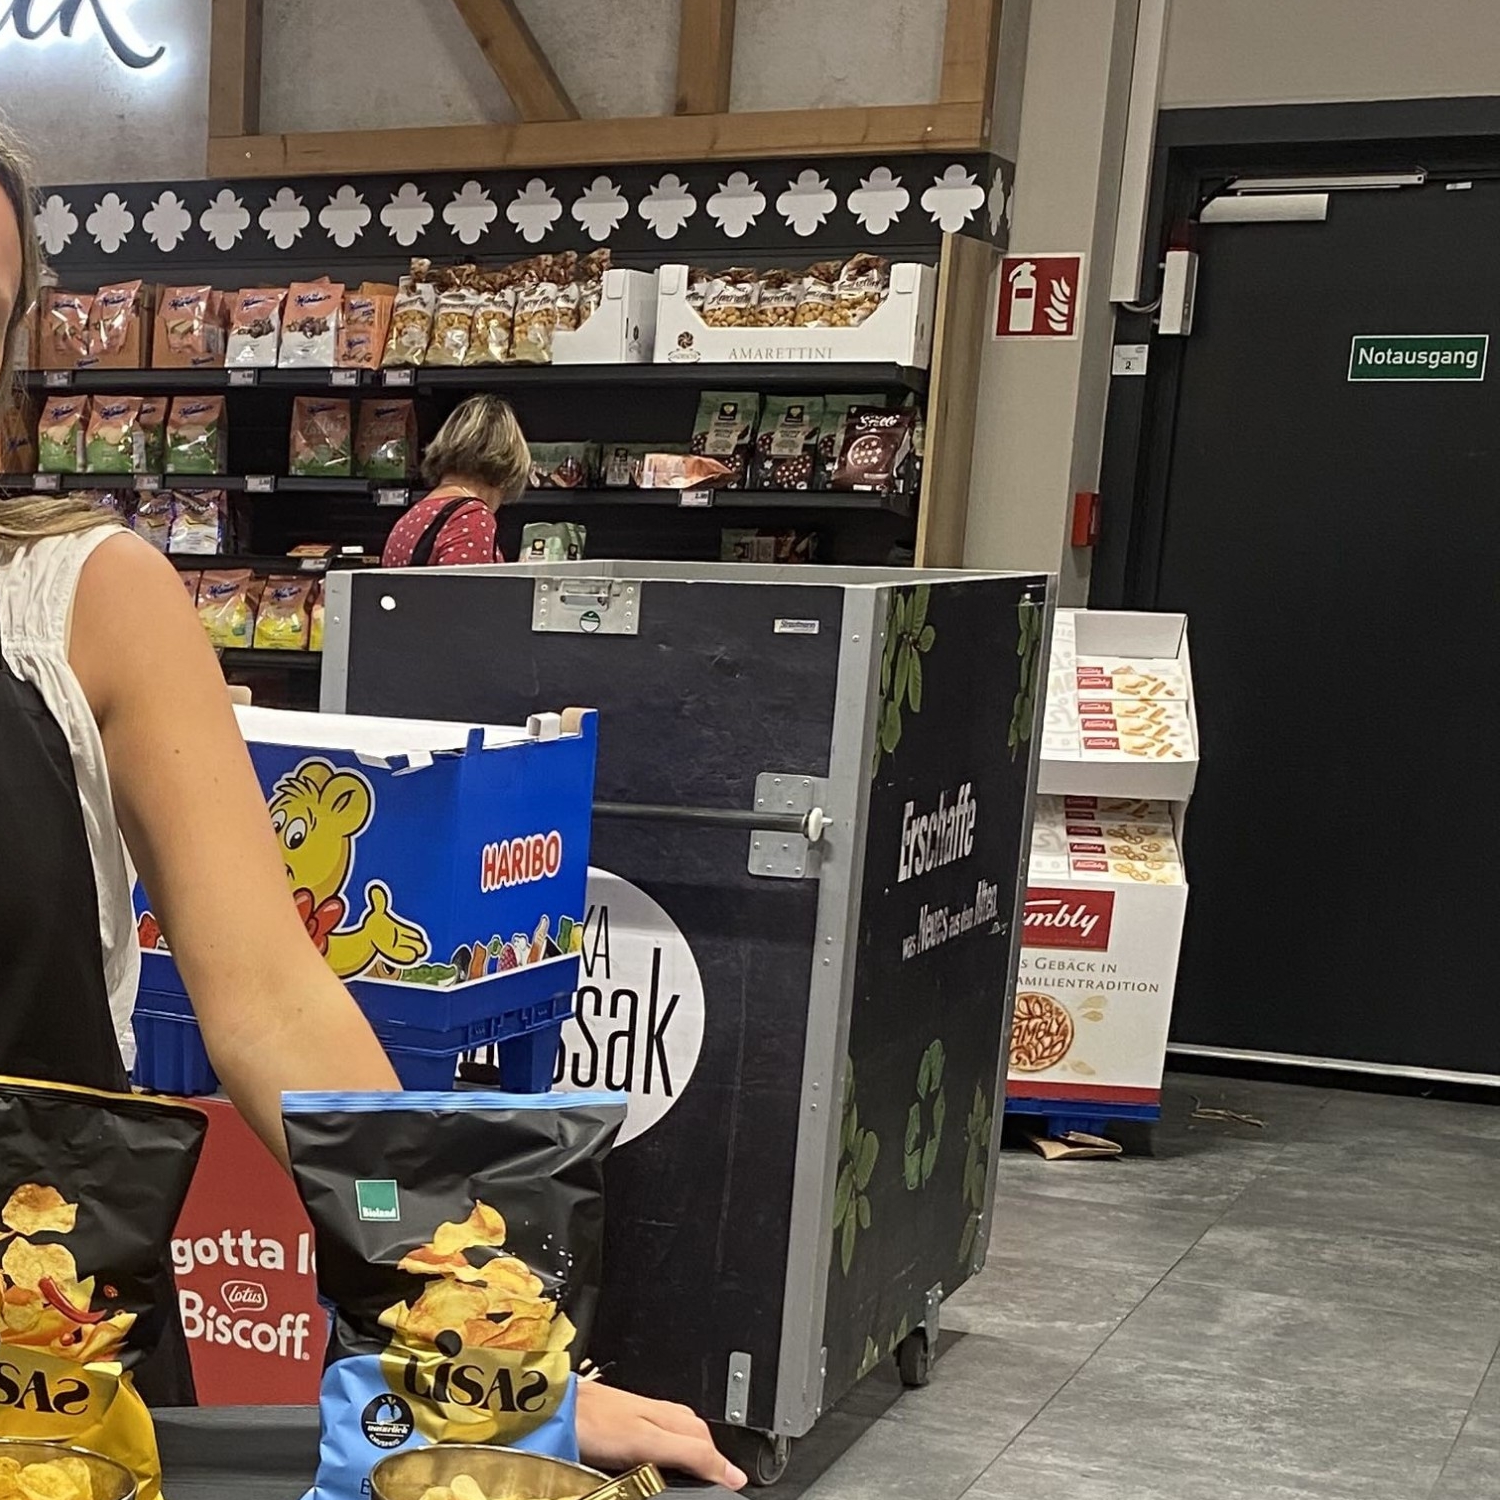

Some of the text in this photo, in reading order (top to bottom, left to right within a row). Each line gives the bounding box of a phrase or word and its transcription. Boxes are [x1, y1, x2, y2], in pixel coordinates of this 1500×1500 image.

[728, 347, 833, 361] AMARETTINI
[1358, 347, 1478, 369] Notausgang
[898, 782, 976, 882] Erschaffe
[482, 830, 562, 892] HARIBO
[1101, 963, 1117, 973] IN
[1018, 976, 1160, 993] AMILIENTRADITION
[1012, 1016, 1068, 1044] AMBLY
[363, 1207, 396, 1219] Bioland
[171, 1229, 317, 1275] gotta l
[228, 1285, 262, 1303] Lotus
[179, 1289, 311, 1361] Biscoff
